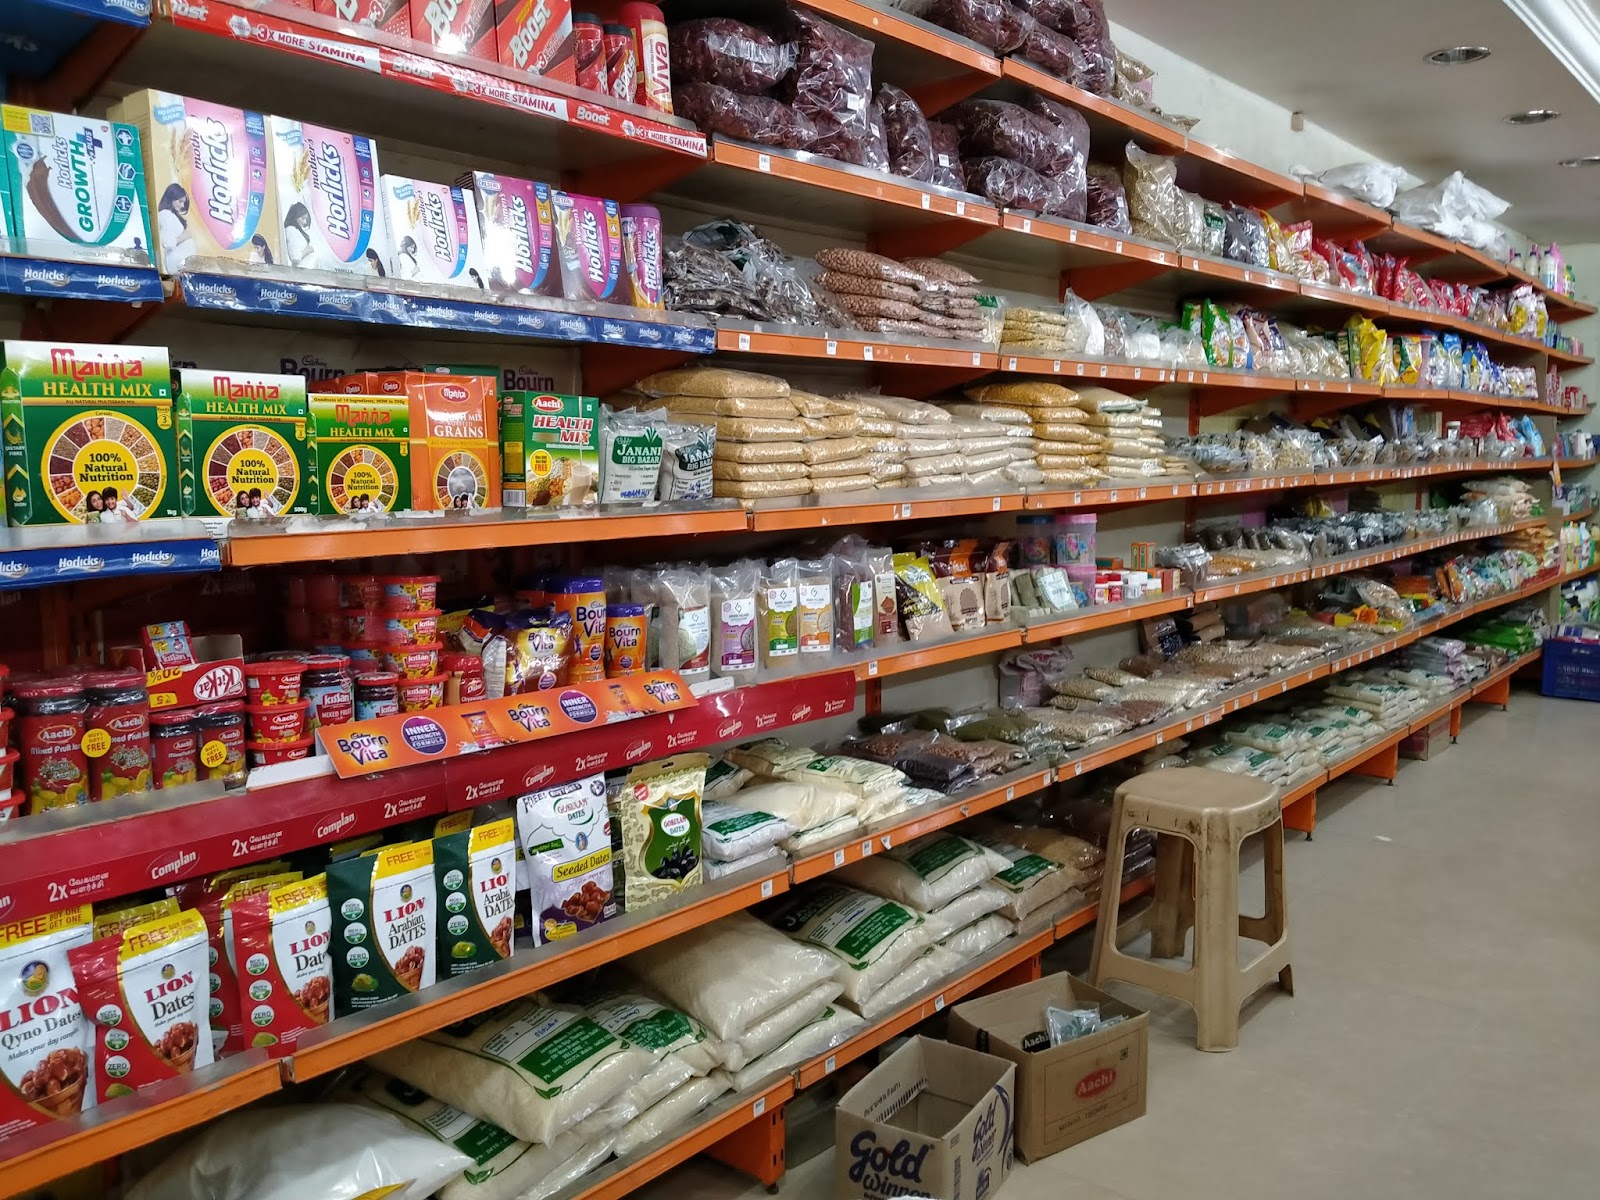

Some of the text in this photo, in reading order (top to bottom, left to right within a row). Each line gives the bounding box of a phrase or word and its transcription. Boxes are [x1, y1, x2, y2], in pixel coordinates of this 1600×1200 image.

[277, 33, 366, 64] MORE STAMINA
[488, 87, 557, 114] MORE STAMINA
[576, 106, 611, 126] Boost
[650, 131, 705, 153] MORE STAMINA
[52, 135, 72, 190] Horlicks
[201, 115, 235, 226] Horlicks
[304, 138, 321, 190] mother's
[68, 139, 95, 233] GROWTH
[316, 141, 350, 241] Horlicks
[417, 190, 429, 227] mother's
[426, 191, 452, 263] Horlicks
[507, 194, 534, 274] Horlicks
[571, 208, 583, 245] Women's
[581, 208, 605, 283] Horlicks
[642, 231, 658, 290] Horlicks
[24, 267, 135, 287] Horlicks Horlicks
[198, 283, 233, 295] Horlicks
[260, 288, 293, 300] Horlicks
[319, 294, 349, 305] Horlicks
[372, 299, 400, 311] Horlicks
[474, 310, 499, 321] Horlicks
[517, 315, 542, 325] Horlicks
[559, 319, 582, 330] Horlicks
[50, 348, 143, 382] Manna
[503, 369, 554, 391] Bourn
[43, 381, 153, 397] HEALTH MIX
[213, 376, 279, 402] Manna
[443, 387, 467, 401] Manna
[206, 402, 287, 415] HEALTH MIX
[535, 398, 561, 408] Aachi
[162, 415, 168, 424] 3
[335, 404, 392, 427] Manna
[468, 413, 483, 422] MIX
[533, 414, 594, 430] HEALTH
[330, 427, 395, 437] HEALTH MIX
[433, 425, 484, 438] GRAINS
[559, 430, 591, 445] MIX
[89, 452, 122, 463] 100%
[617, 444, 662, 456] JANANI
[84, 463, 128, 473] Natural
[240, 459, 265, 468] 100%
[534, 464, 548, 472] FREE
[622, 456, 660, 464] BIG BAZAR
[687, 462, 699, 470] BIG
[79, 472, 135, 483] Nutrition
[231, 475, 275, 484] Nutrition
[236, 468, 270, 476] Natural
[353, 471, 372, 479] 100%
[166, 509, 177, 517] 1kg
[59, 551, 170, 569] Horlicks Horlicks
[609, 627, 641, 638] Bourn
[532, 641, 554, 652] Vita
[614, 637, 637, 649] Vita
[643, 682, 679, 696] Bourn
[561, 698, 587, 707] INNER
[654, 692, 681, 705] Vita
[276, 713, 297, 724] Aachi
[507, 707, 550, 721] Bourn
[568, 709, 595, 718] FORMULA
[791, 705, 812, 721] Complan
[114, 717, 143, 729] Aachi
[405, 723, 438, 736] INNER
[519, 718, 551, 732] Vita
[718, 720, 742, 738] Complan
[41, 730, 74, 740] Aachi
[409, 731, 441, 741] STRENGTH
[412, 737, 444, 748] FORMULA
[54, 745, 71, 753] Fruit
[87, 742, 106, 752] FREE
[175, 740, 193, 749] Aachi
[337, 735, 389, 752] Bourn
[626, 741, 652, 761] Complan
[206, 753, 224, 765] FREE
[350, 749, 389, 765] Vita
[525, 765, 554, 788] Complan
[384, 802, 398, 819] 2x
[556, 798, 588, 814] GOKULAM
[567, 810, 586, 821] DATES
[663, 816, 687, 828] GOKULAM
[317, 812, 355, 839] Complan
[669, 825, 685, 834] DATES
[478, 827, 500, 842] FREE
[231, 839, 249, 857] 2x
[151, 850, 197, 880] Complan
[386, 851, 415, 867] FREE
[556, 853, 610, 879] Seeded Dates
[47, 882, 68, 903] 2x
[275, 886, 310, 906] FREE
[49, 906, 82, 921] BUY ONE
[383, 897, 425, 923] LION
[50, 914, 82, 930] GET ONE
[388, 913, 425, 937] Arabian
[128, 926, 168, 952] FREE
[389, 923, 426, 950] DATES
[144, 969, 195, 1004] LION
[0, 987, 79, 1032] LION
[151, 990, 195, 1021] Dates
[253, 1011, 271, 1019] ZERO
[1, 1009, 82, 1050] Qyno Dates
[8, 1036, 59, 1061] Makes your day
[1024, 1032, 1049, 1049] Aachi
[107, 1062, 128, 1070] ZERO
[1076, 1069, 1114, 1095] Aachi
[848, 1130, 931, 1184] Gold
